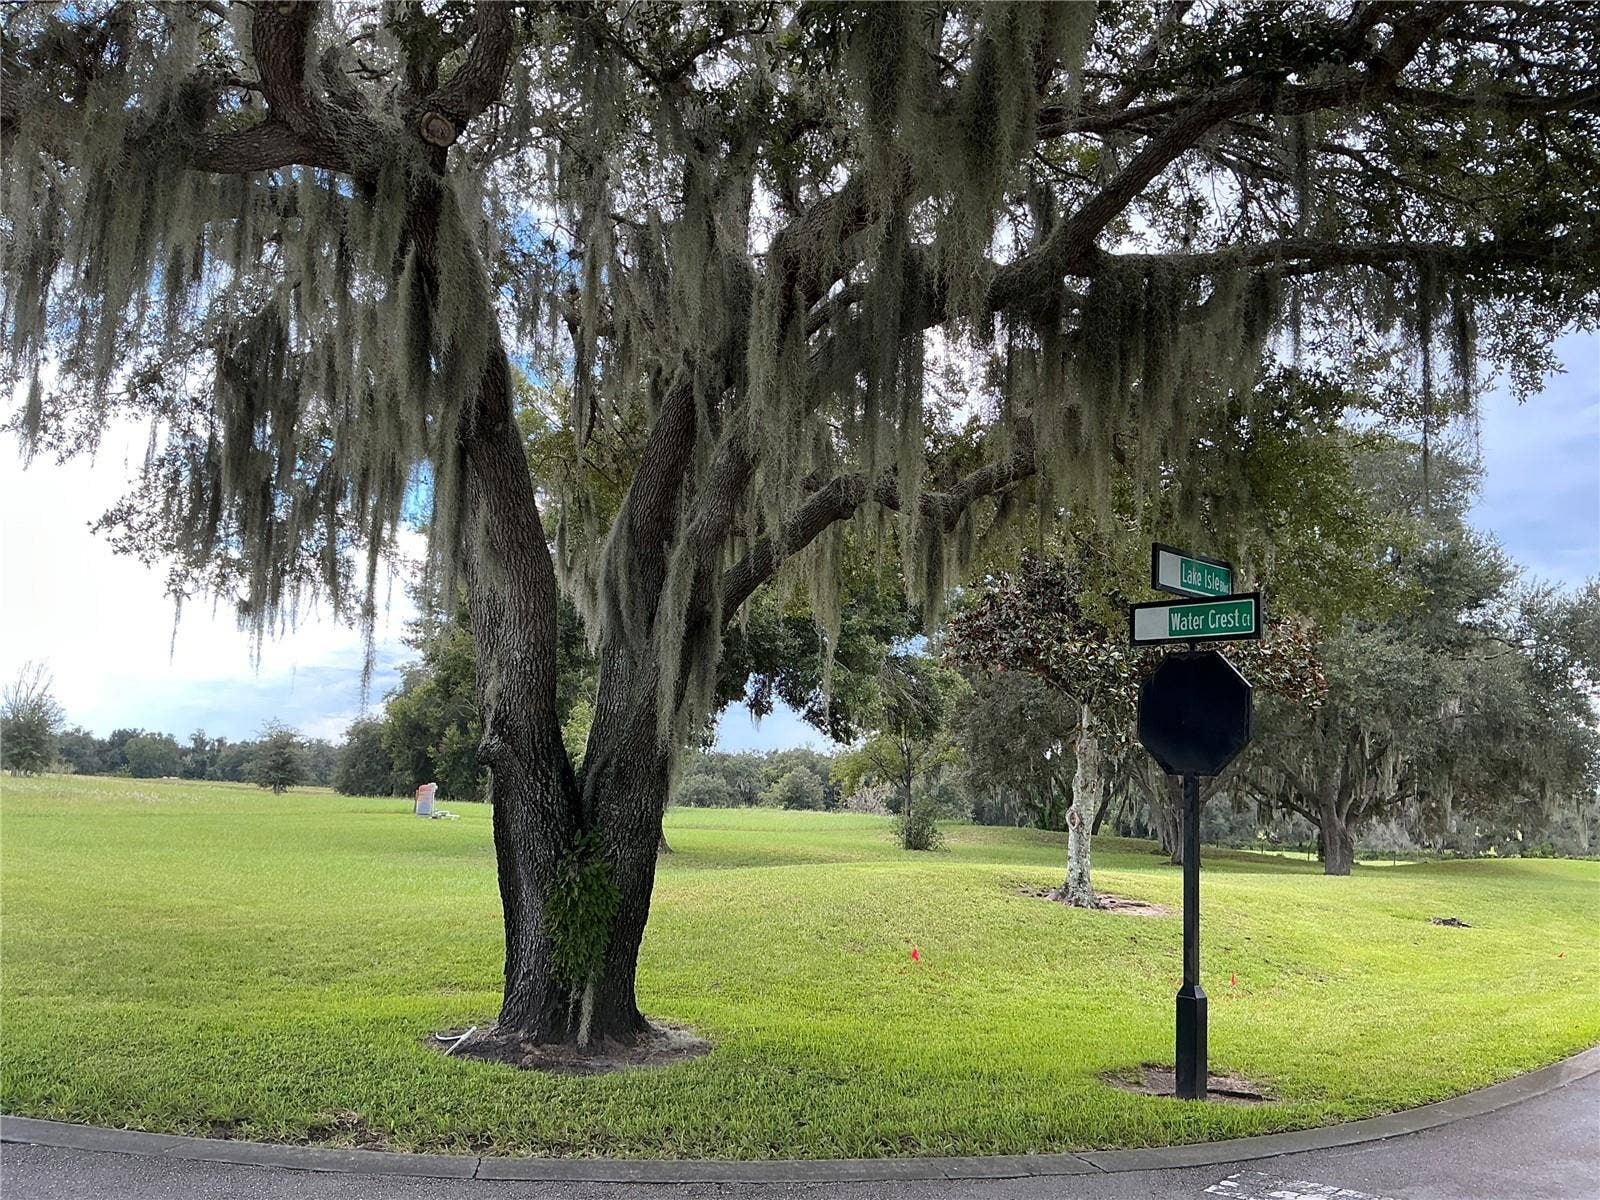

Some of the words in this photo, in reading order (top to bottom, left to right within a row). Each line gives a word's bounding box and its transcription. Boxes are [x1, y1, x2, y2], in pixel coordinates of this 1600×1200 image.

[1182, 563, 1202, 586] Lake
[1204, 569, 1219, 591] Isle
[1171, 613, 1204, 631] Water
[1208, 608, 1240, 628] Crest
[1241, 613, 1251, 626] Ct
